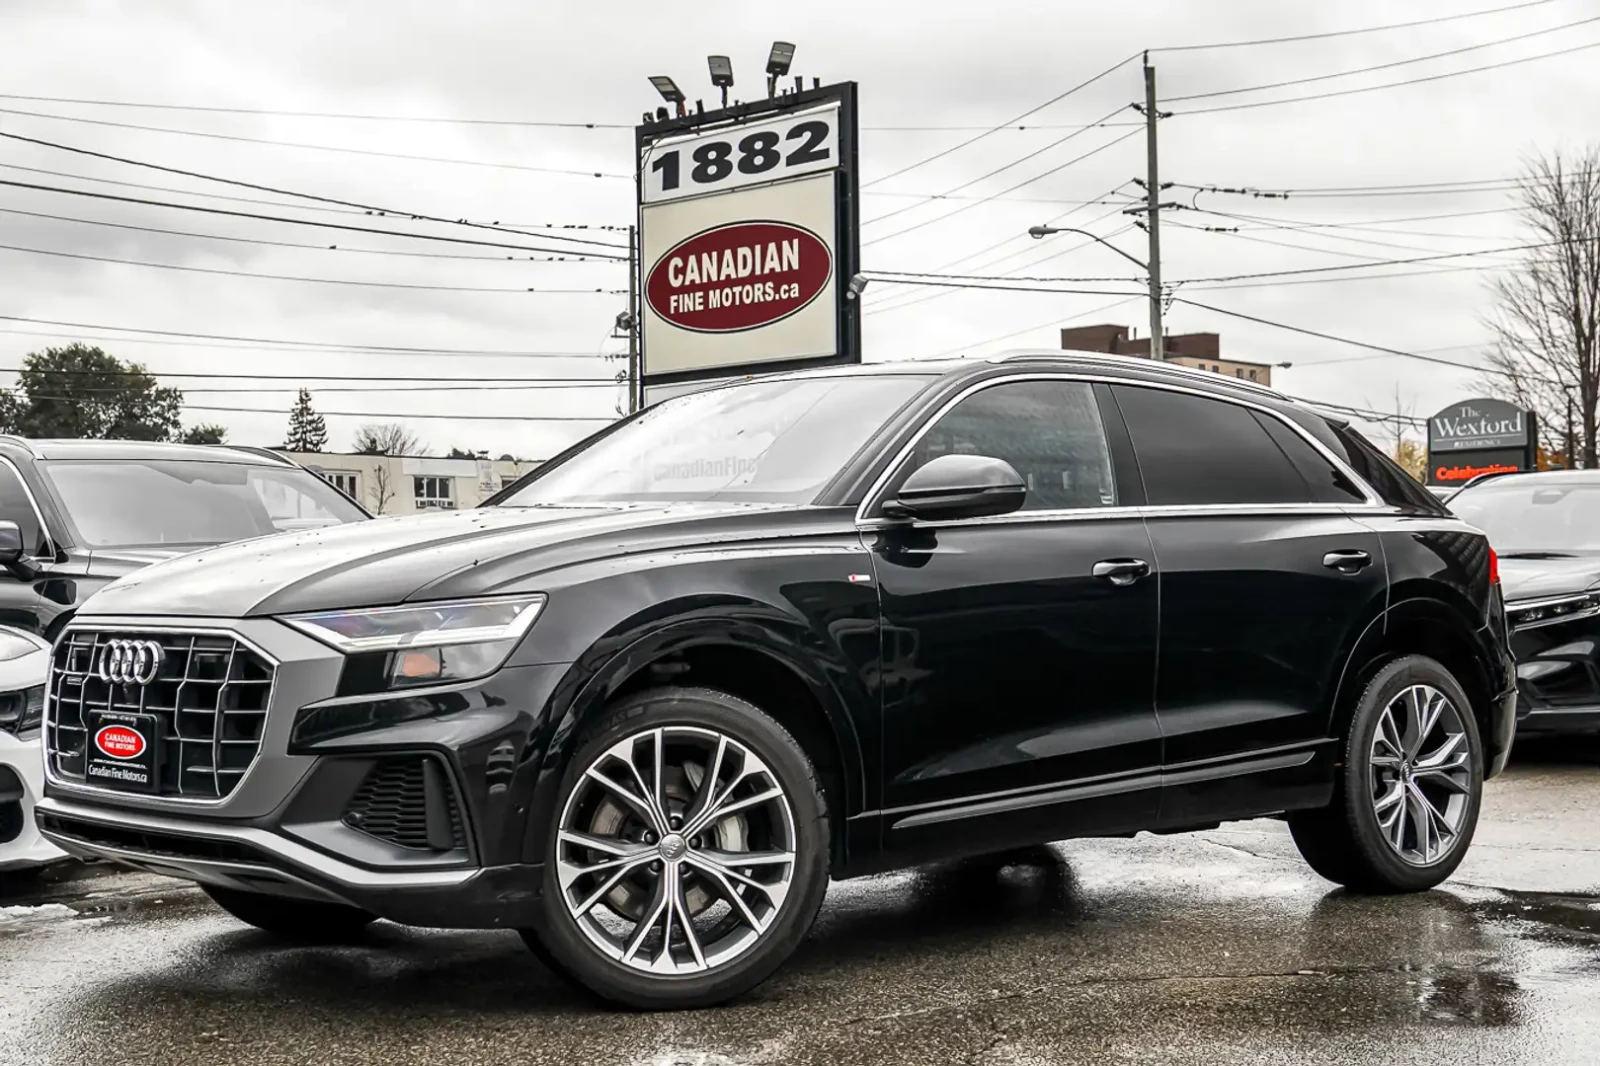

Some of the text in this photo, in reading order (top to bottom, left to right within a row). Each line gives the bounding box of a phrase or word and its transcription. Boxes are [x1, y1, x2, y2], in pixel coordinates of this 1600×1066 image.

[652, 120, 830, 191] 1882
[668, 238, 800, 288] CANADIAN
[669, 282, 800, 315] FINE MOTORS.ca
[1435, 411, 1521, 437] Wexford
[1459, 406, 1482, 418] The
[104, 733, 137, 744] CANADIAN
[104, 741, 116, 749] FINE
